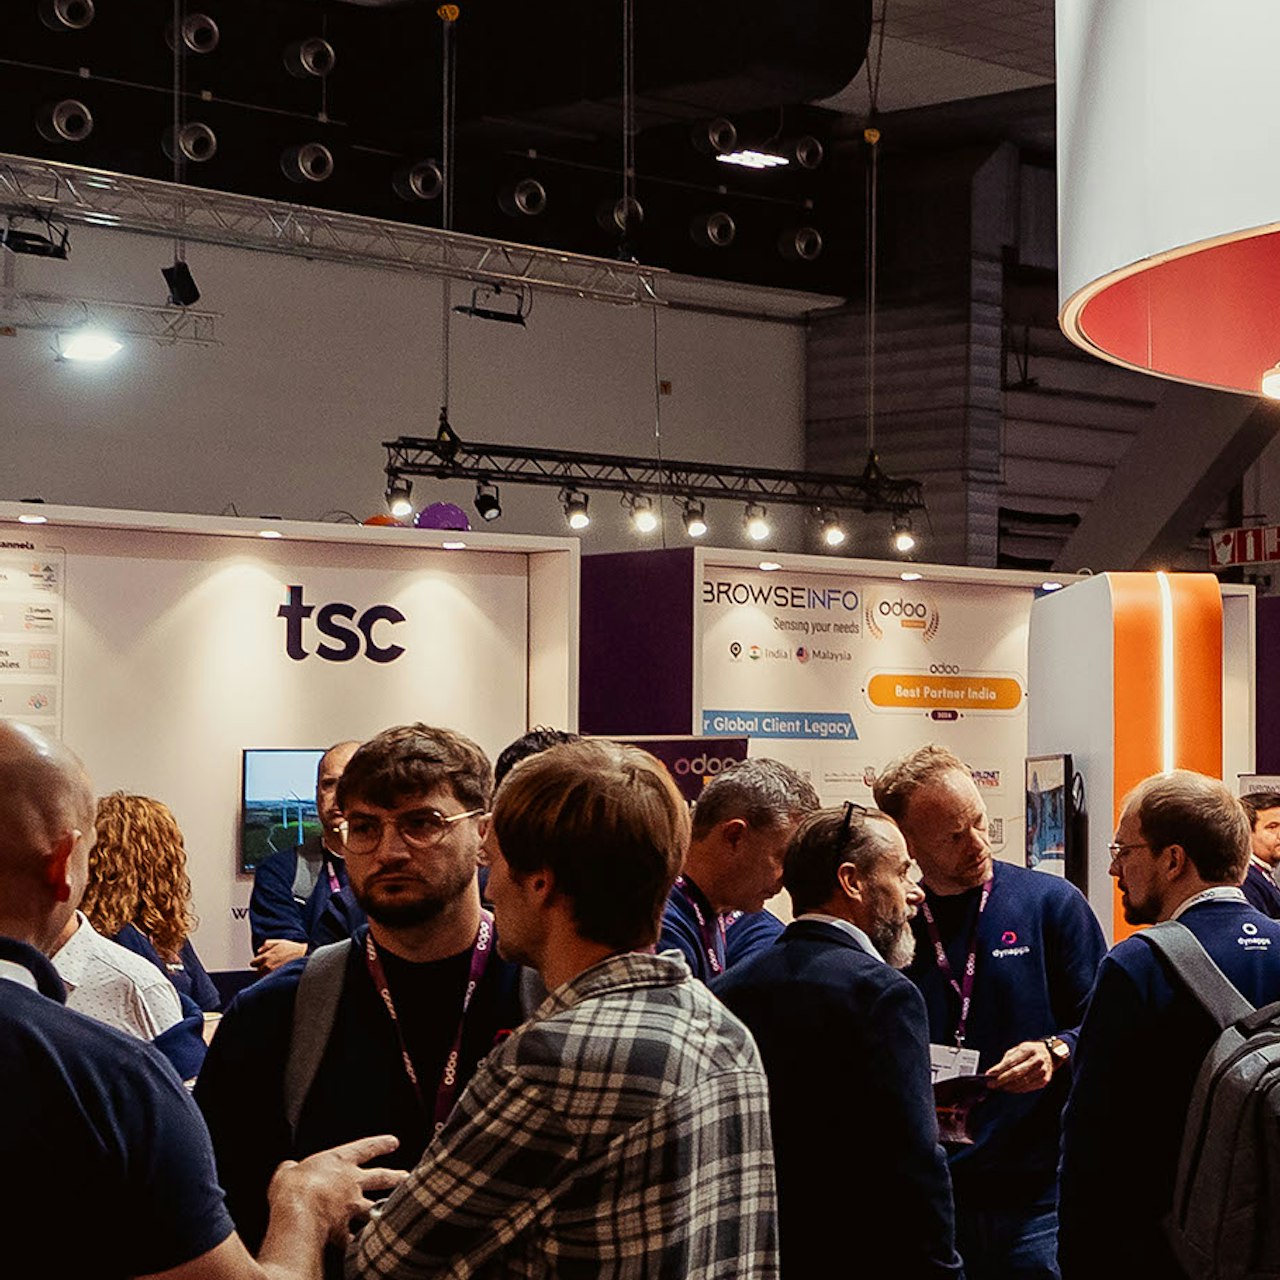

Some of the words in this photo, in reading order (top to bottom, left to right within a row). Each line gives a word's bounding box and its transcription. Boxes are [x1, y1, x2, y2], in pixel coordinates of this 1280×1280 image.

[0, 540, 35, 551] annels
[702, 581, 860, 611] BROWSEINFO
[879, 598, 928, 618] odoo
[277, 584, 407, 664] tsc
[773, 617, 809, 634] Sensing
[811, 621, 831, 635] your
[832, 622, 860, 634] needs
[0, 659, 20, 669] ales
[765, 647, 788, 660] India
[812, 651, 852, 664] Malaysia
[929, 662, 960, 675] odoo
[895, 684, 921, 699] Best
[923, 684, 965, 700] Partner
[967, 686, 997, 701] India
[713, 716, 759, 732] Global
[762, 719, 801, 734] Client
[804, 721, 853, 737] Legacy
[674, 753, 736, 775] odoo
[476, 921, 490, 951] odoo
[1237, 936, 1272, 946] dynapps
[991, 945, 1031, 959] dynapps
[966, 952, 976, 976] odoo
[444, 1050, 458, 1086] odoo
